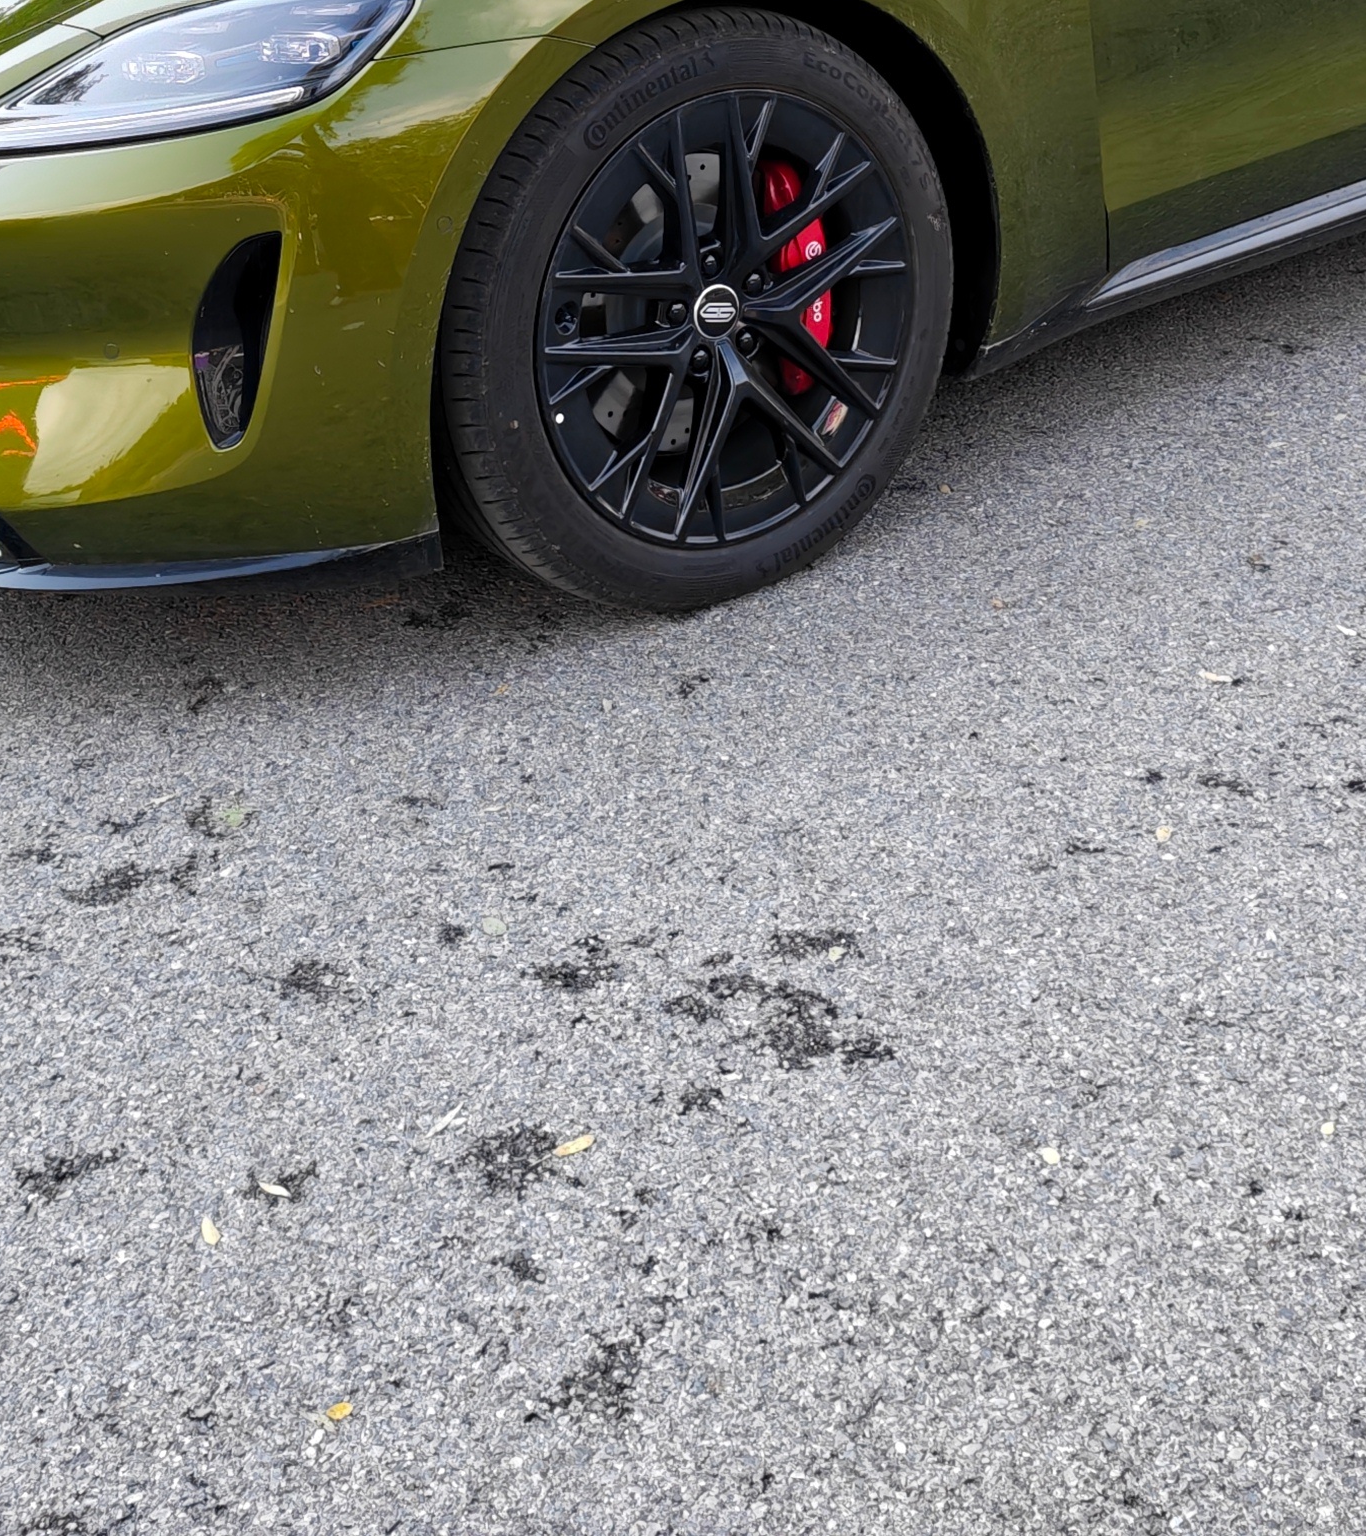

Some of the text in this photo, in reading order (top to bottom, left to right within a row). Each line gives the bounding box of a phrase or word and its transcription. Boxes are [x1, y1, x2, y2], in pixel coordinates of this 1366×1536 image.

[583, 56, 700, 150] Continental
[802, 50, 914, 155] EcoContact
[772, 472, 877, 572] Continental
